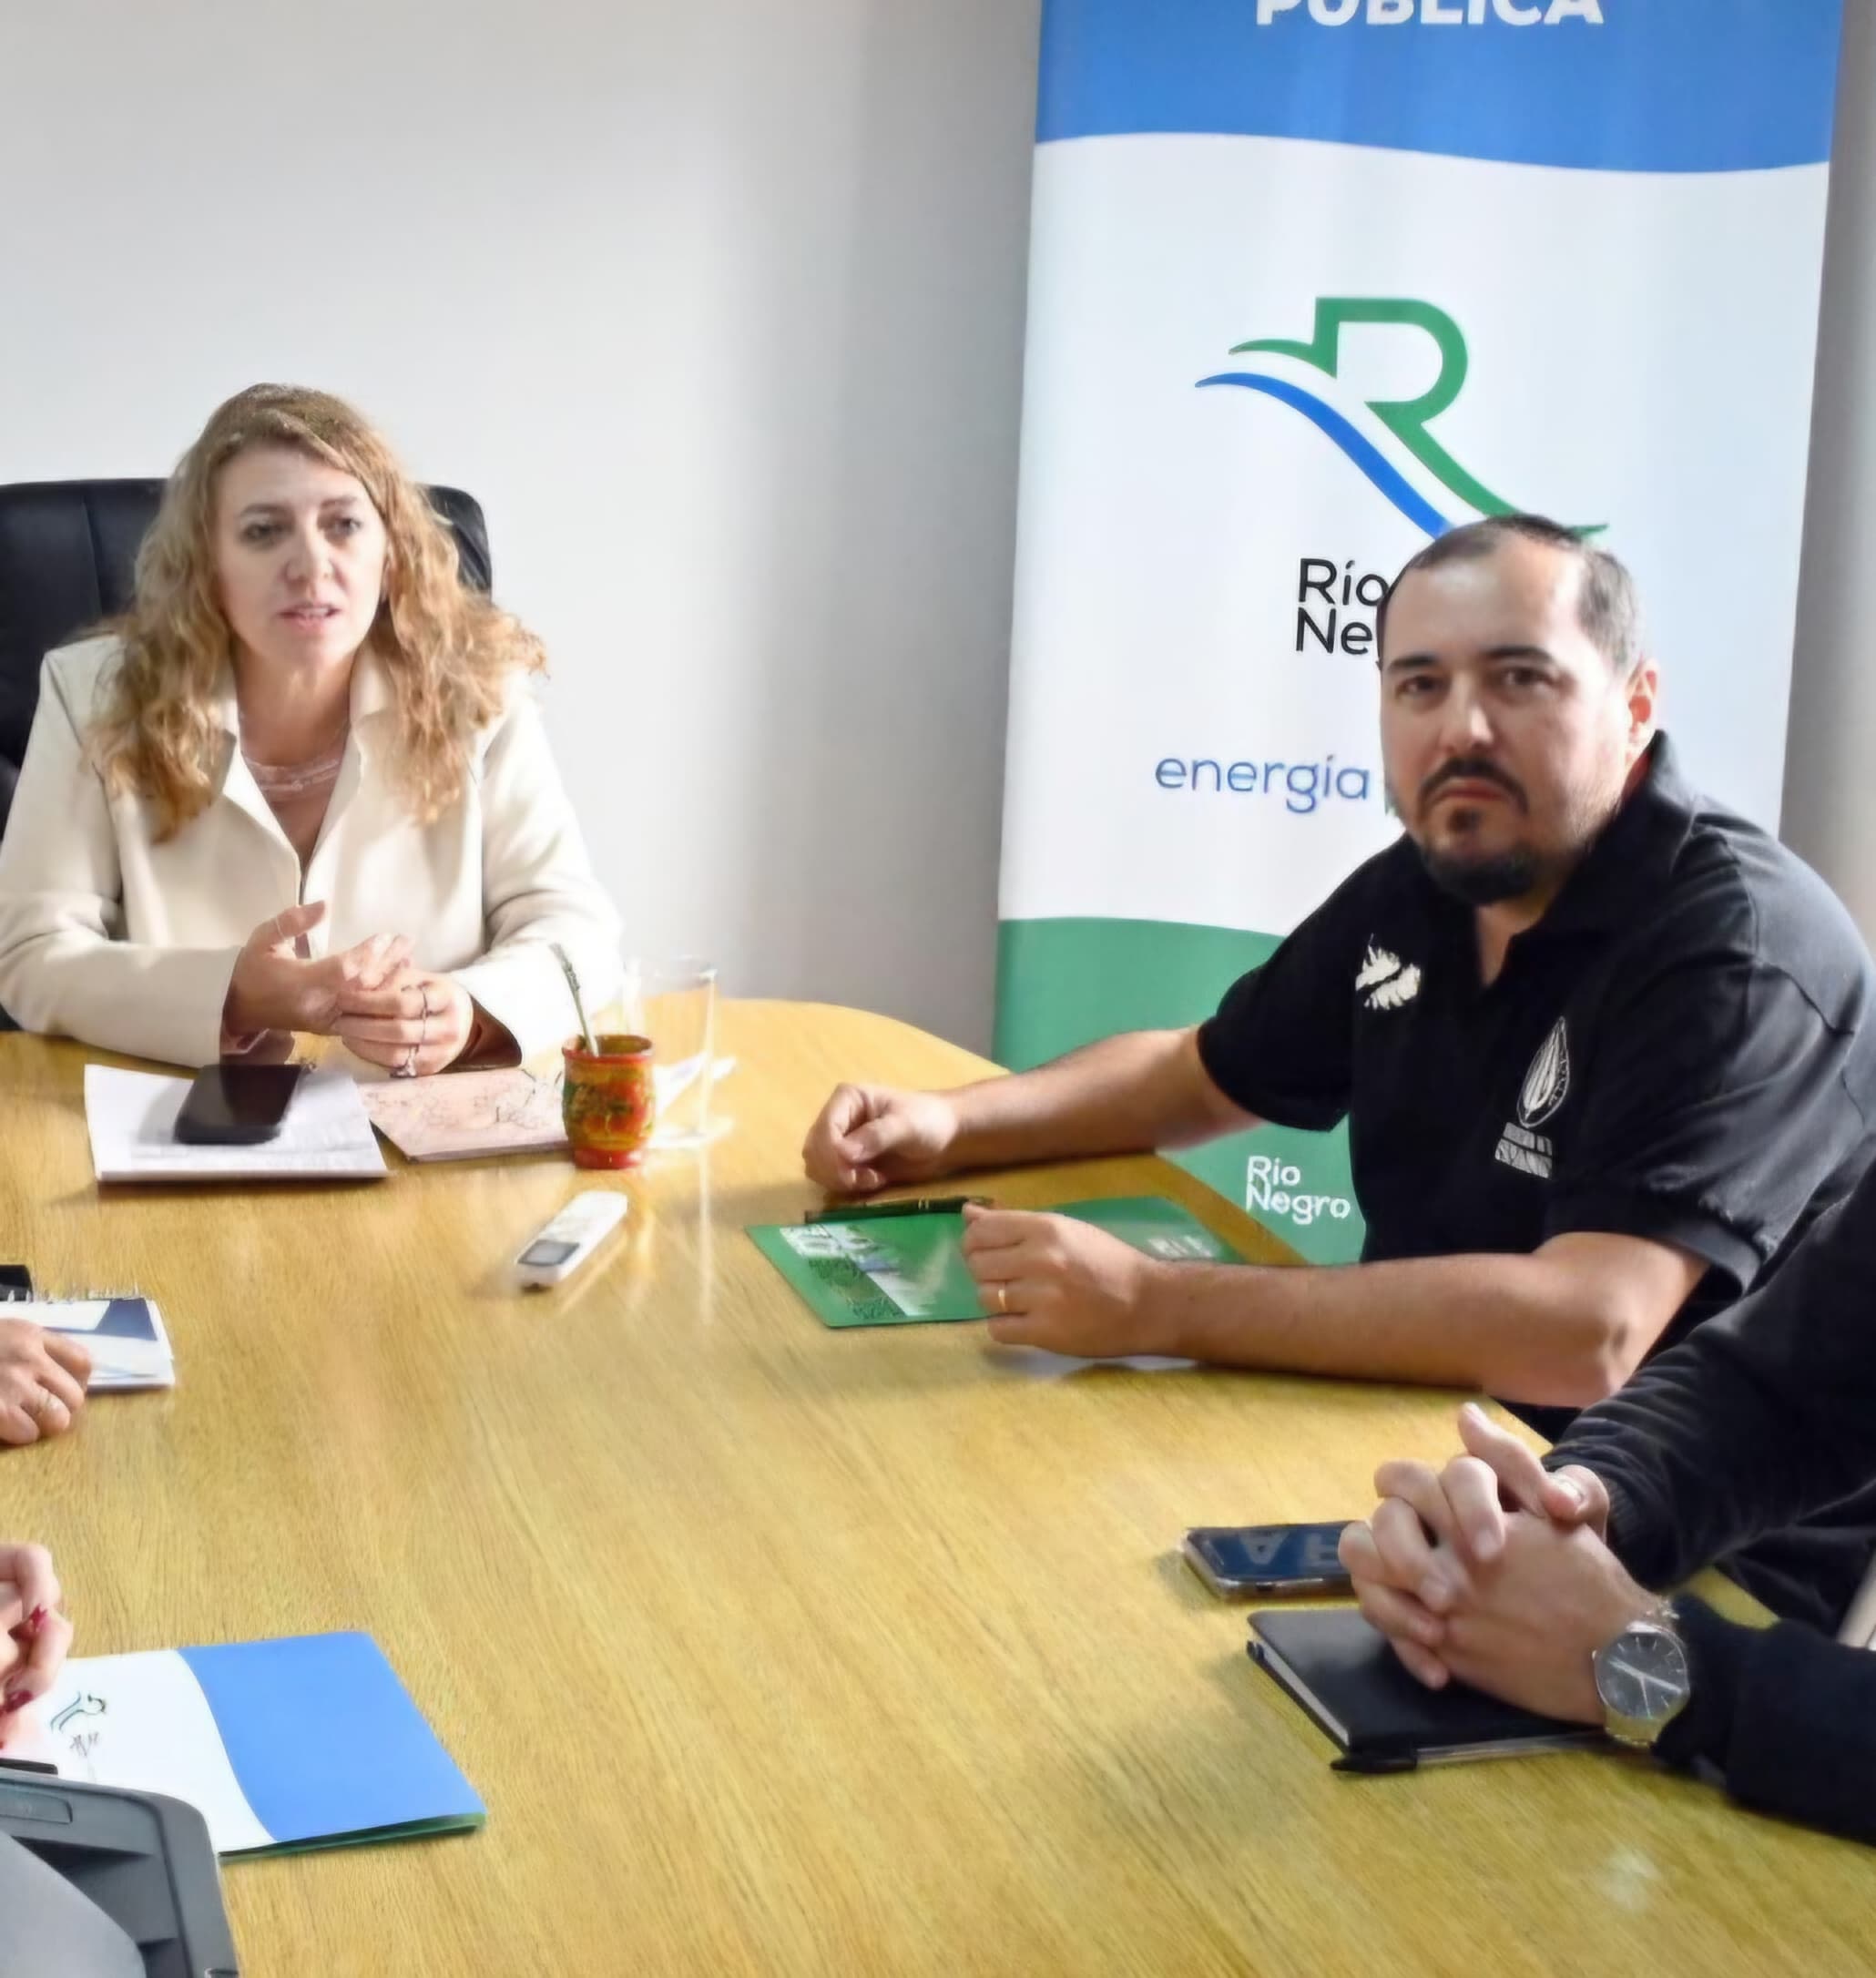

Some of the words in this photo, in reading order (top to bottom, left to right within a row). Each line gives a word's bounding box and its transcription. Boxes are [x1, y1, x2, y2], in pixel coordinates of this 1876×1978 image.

[1298, 557, 1390, 607] Río
[1154, 753, 1370, 813] energía
[1246, 1183, 1351, 1225] Negro
